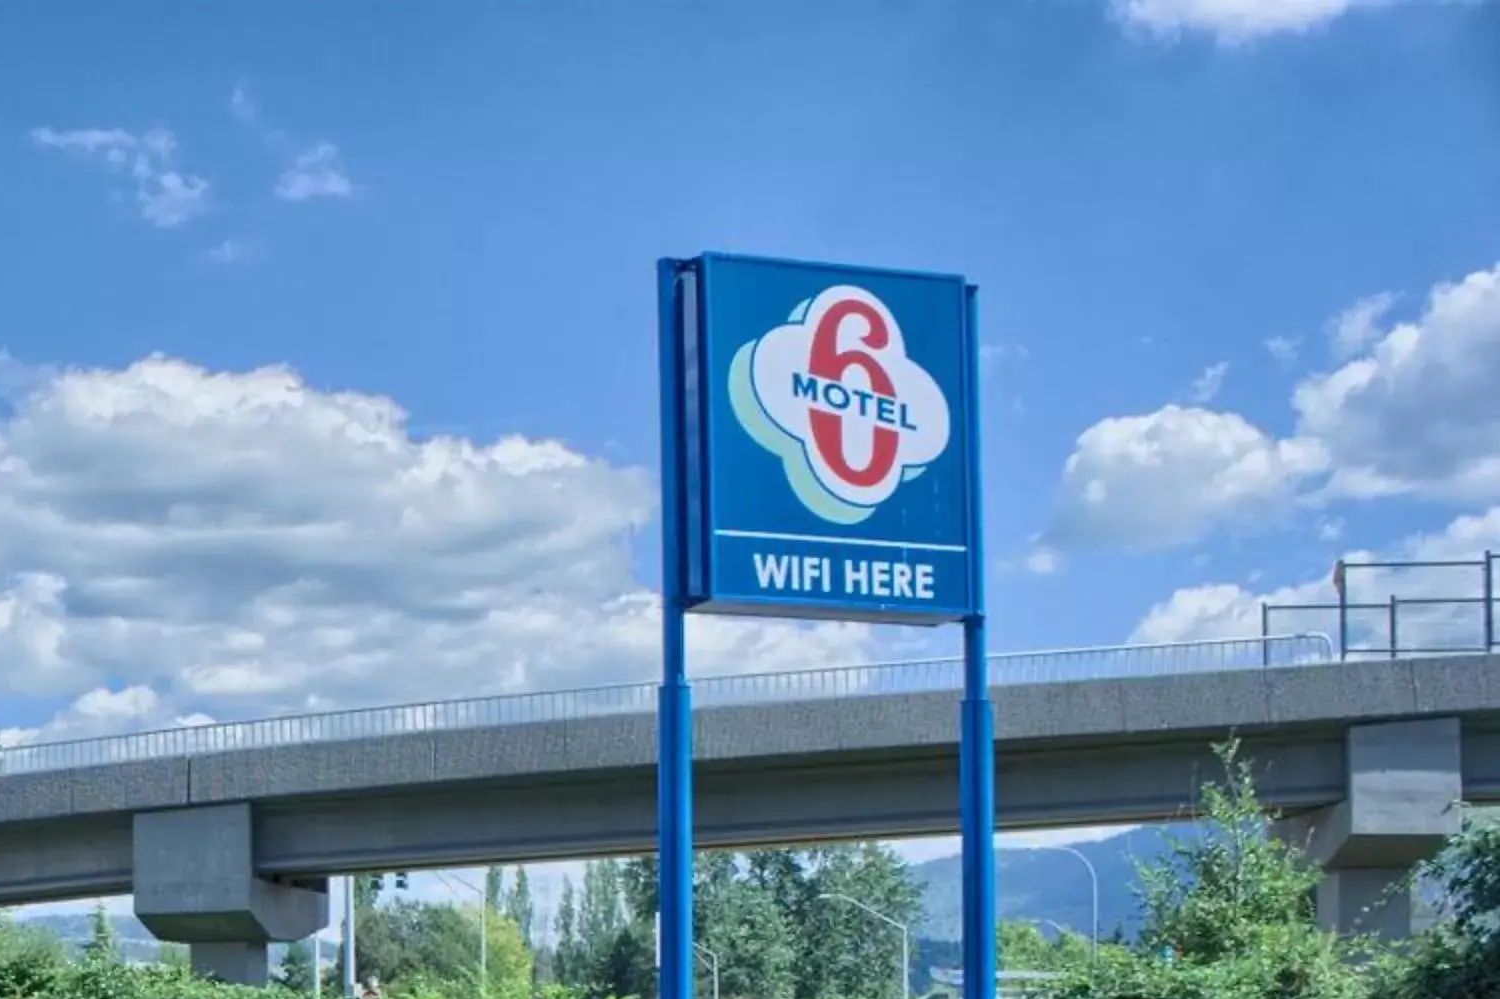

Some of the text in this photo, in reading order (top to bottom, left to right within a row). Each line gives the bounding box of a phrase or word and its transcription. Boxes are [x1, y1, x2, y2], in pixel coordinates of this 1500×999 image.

[792, 372, 917, 431] MOTEL
[808, 298, 899, 488] 6
[753, 553, 935, 599] WIFI HERE
